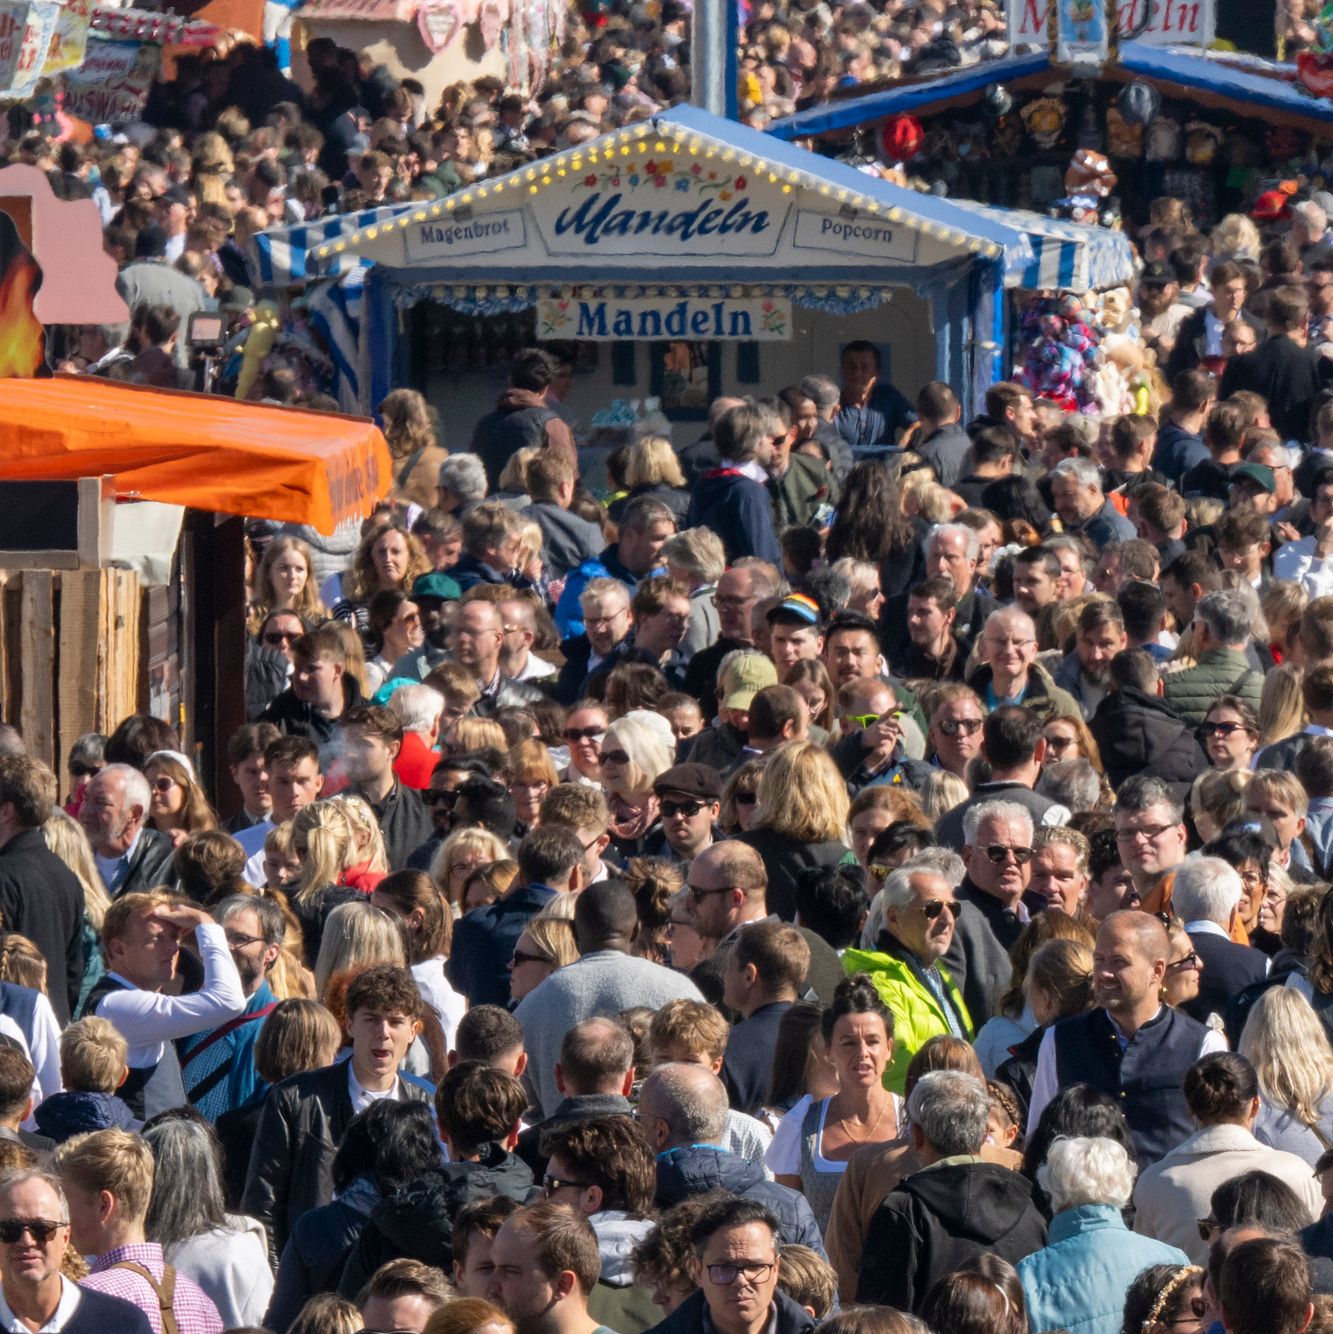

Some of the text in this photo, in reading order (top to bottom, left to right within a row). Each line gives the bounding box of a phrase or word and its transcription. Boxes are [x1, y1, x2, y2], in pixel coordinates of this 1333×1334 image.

[421, 218, 510, 245] Magenbrot
[555, 192, 769, 245] Mandeln
[821, 218, 892, 243] Popcorn
[576, 301, 752, 337] Mandeln
